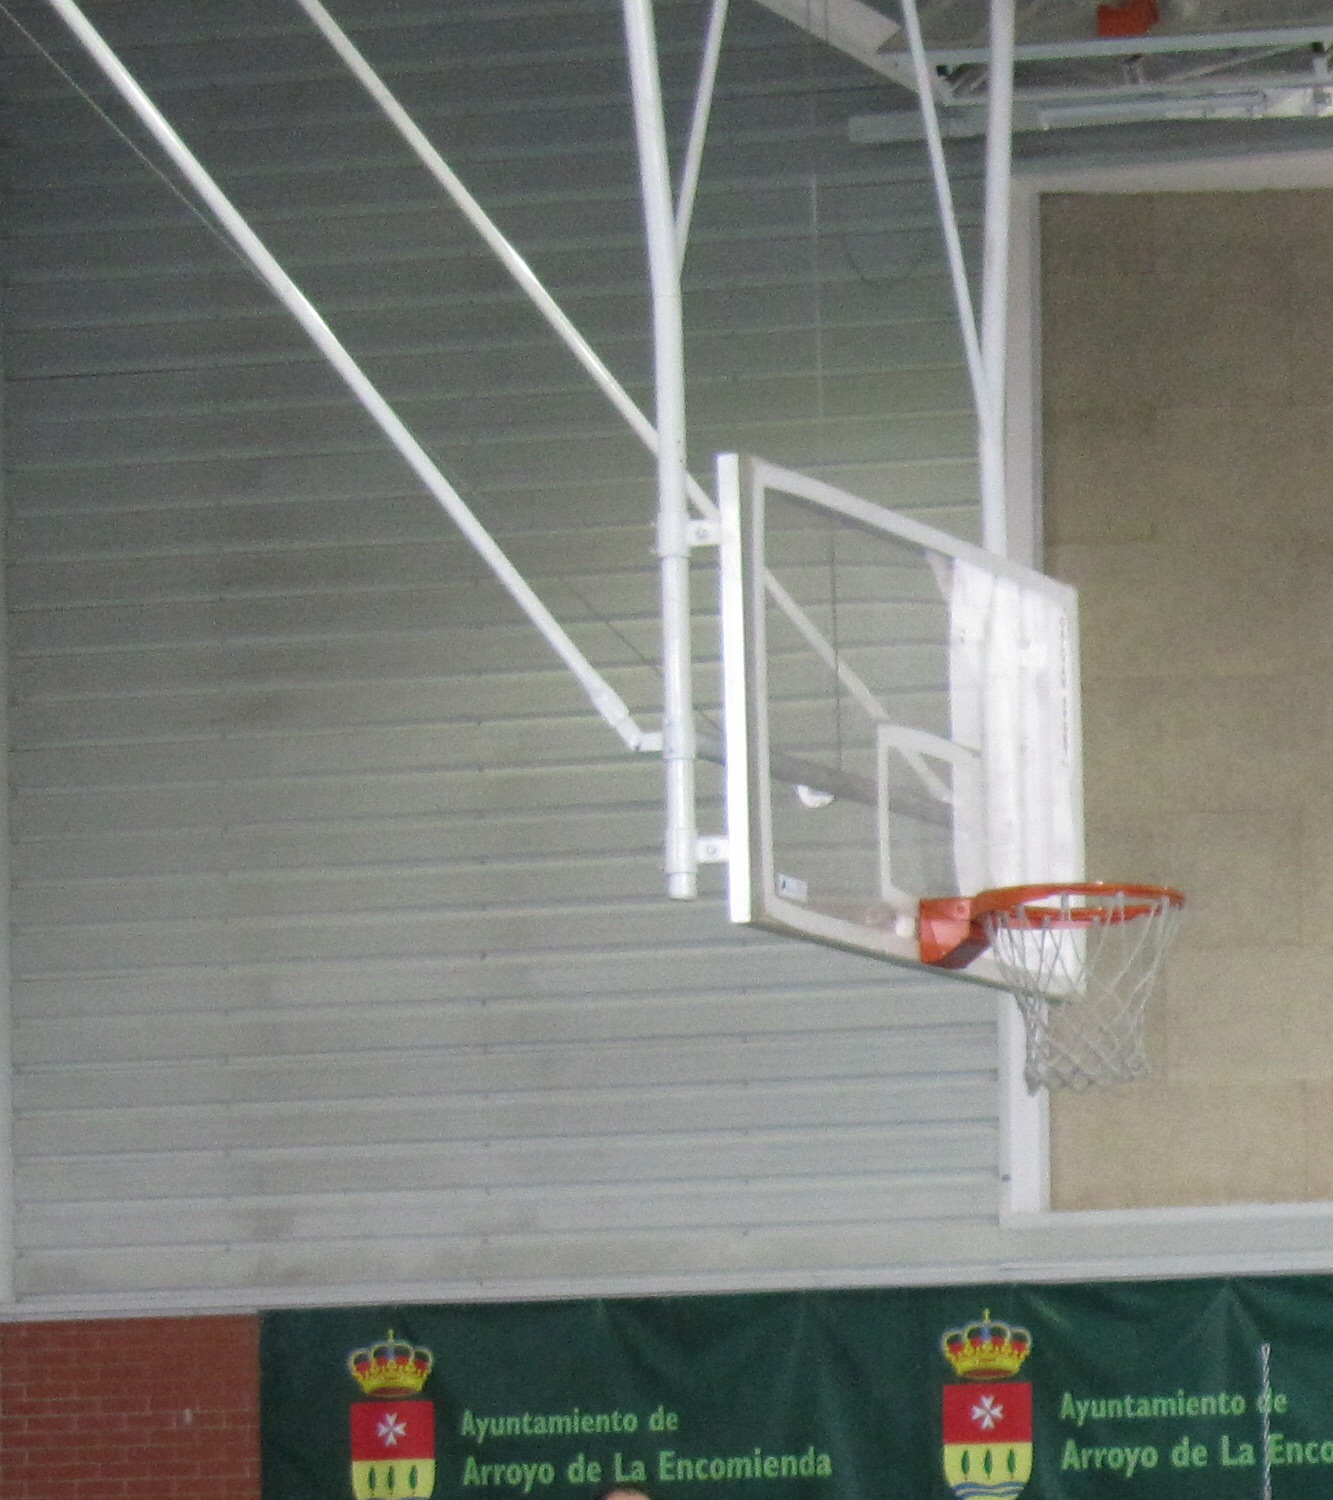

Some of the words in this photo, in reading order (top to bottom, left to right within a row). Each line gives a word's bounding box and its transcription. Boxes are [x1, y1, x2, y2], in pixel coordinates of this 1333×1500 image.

[461, 1407, 639, 1440] Ayuntamiento
[649, 1407, 679, 1431] de
[1060, 1388, 1247, 1425] Ayuntamiento
[1256, 1386, 1288, 1414] de
[462, 1456, 555, 1493] Arroyo
[567, 1453, 602, 1484] de
[614, 1452, 647, 1483] La
[659, 1446, 833, 1482] Encomienda
[1061, 1439, 1158, 1478] Arroyo
[1171, 1436, 1208, 1468] de
[1220, 1435, 1256, 1467] La
